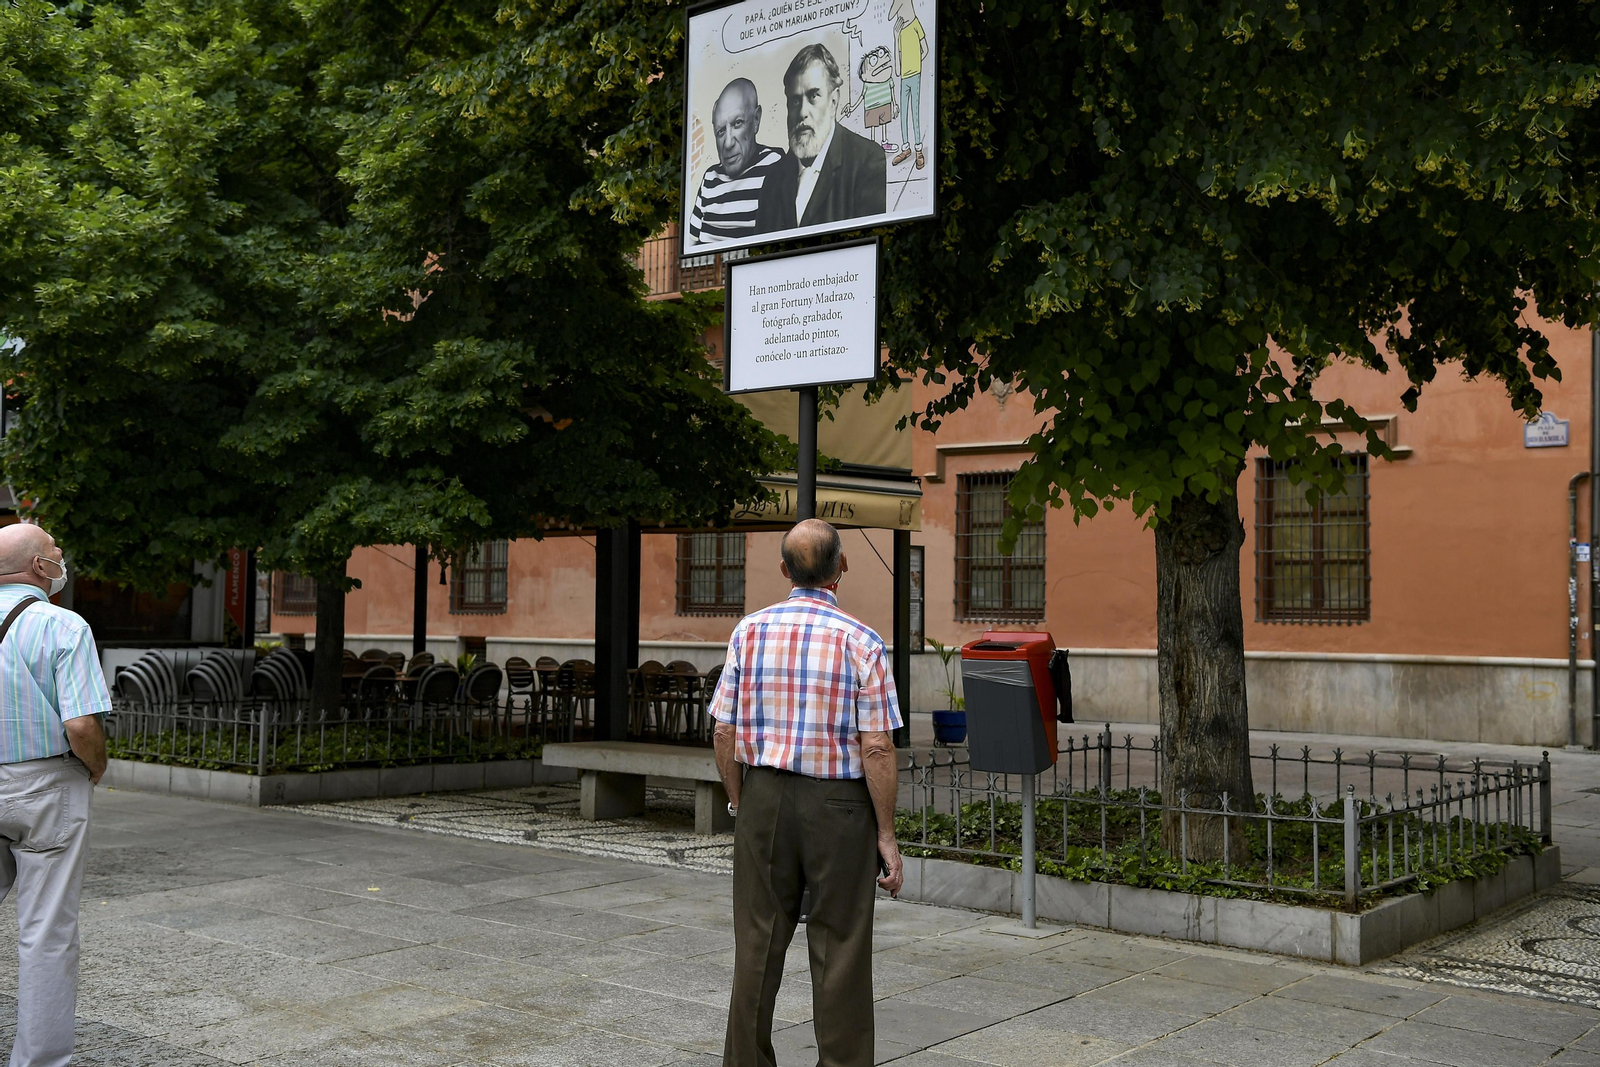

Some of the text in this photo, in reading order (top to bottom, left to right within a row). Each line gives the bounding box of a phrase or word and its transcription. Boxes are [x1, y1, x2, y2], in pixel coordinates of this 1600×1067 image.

[740, 0, 860, 40] QUE VA CON MARIANO FORTUNY?
[768, 1, 792, 21] ¿QUIÉN
[794, 1, 805, 11] ES
[749, 271, 859, 296] Han nombrado embajador
[751, 291, 855, 314] al gran Fortuny Madrazo,
[762, 308, 843, 329] fotógrafo, grabador,
[764, 328, 840, 345] adelantado pintor,
[755, 345, 849, 363] conócelo -un artistazo-
[231, 552, 240, 606] FLAMENCO
